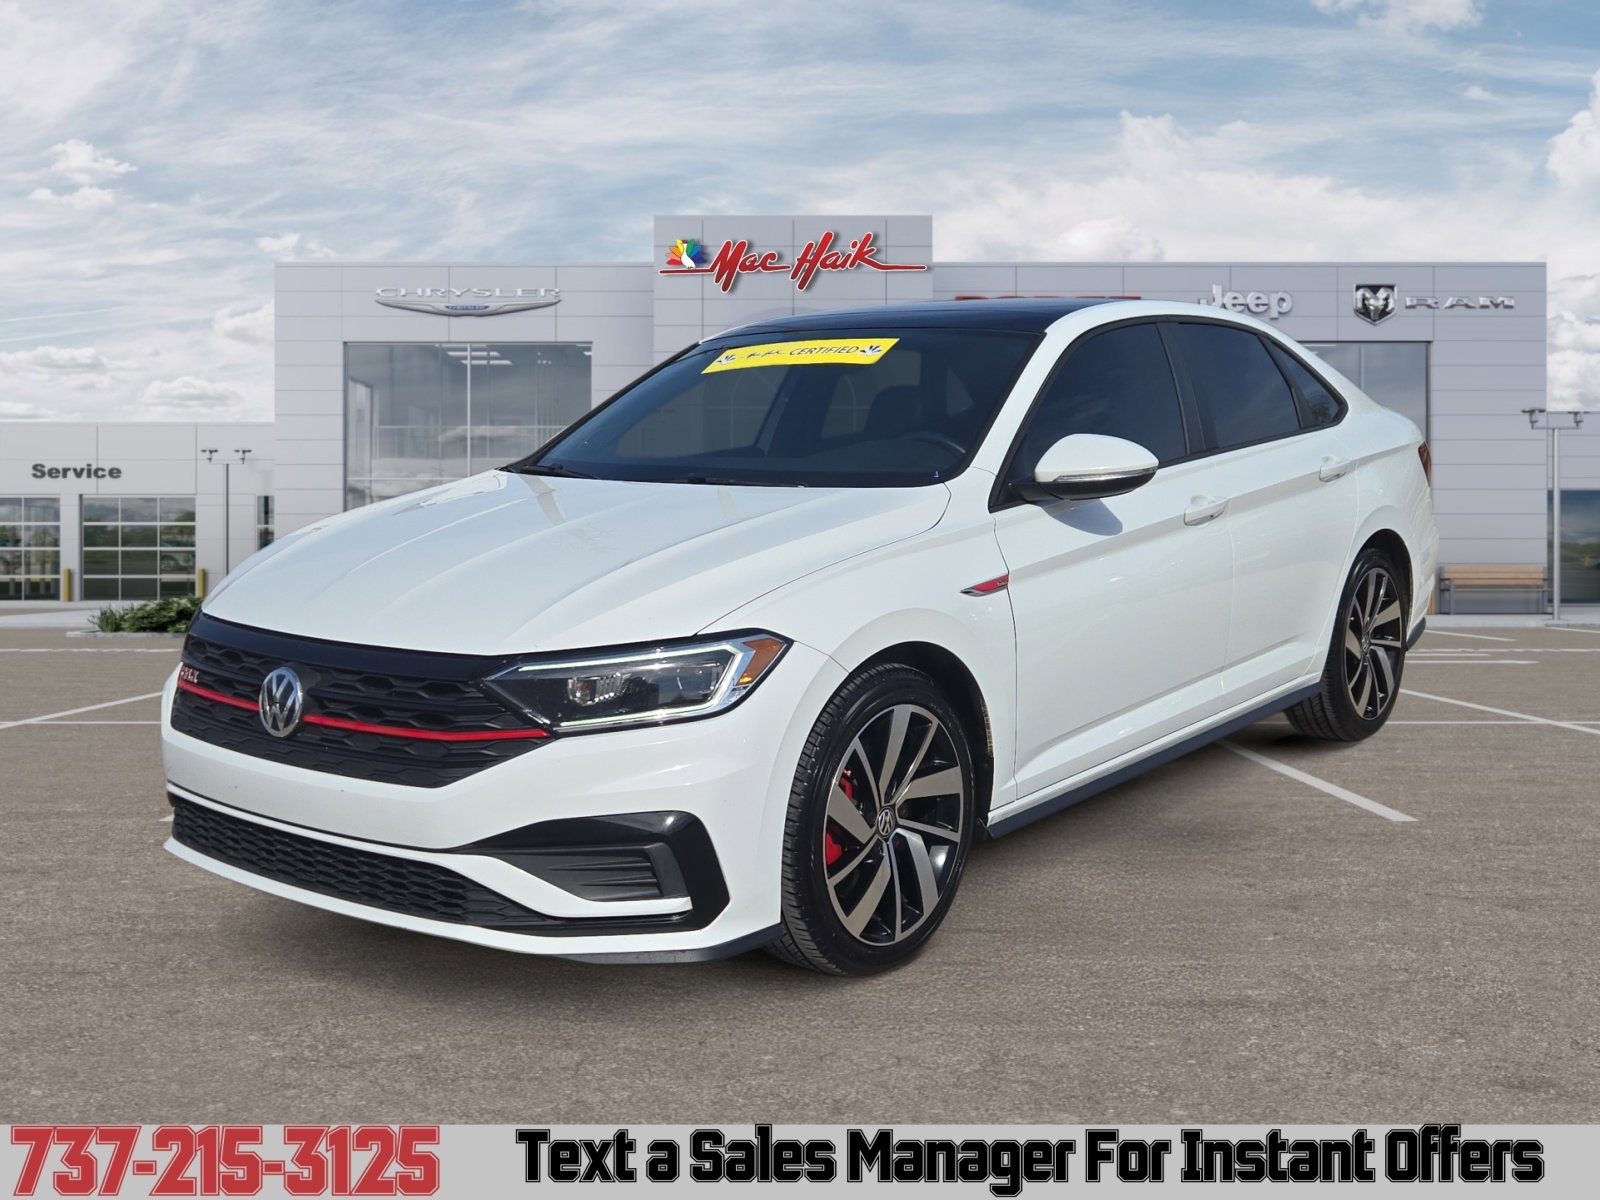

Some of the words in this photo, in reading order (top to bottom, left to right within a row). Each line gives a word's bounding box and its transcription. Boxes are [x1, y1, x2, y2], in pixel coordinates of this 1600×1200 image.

[659, 240, 790, 292] Mac
[789, 231, 927, 291] Haik
[375, 287, 561, 298] CHRYSLER
[1198, 284, 1293, 320] Jeep
[1405, 296, 1515, 309] RAM
[789, 346, 859, 356] CERTIFIED
[31, 463, 122, 479] Service
